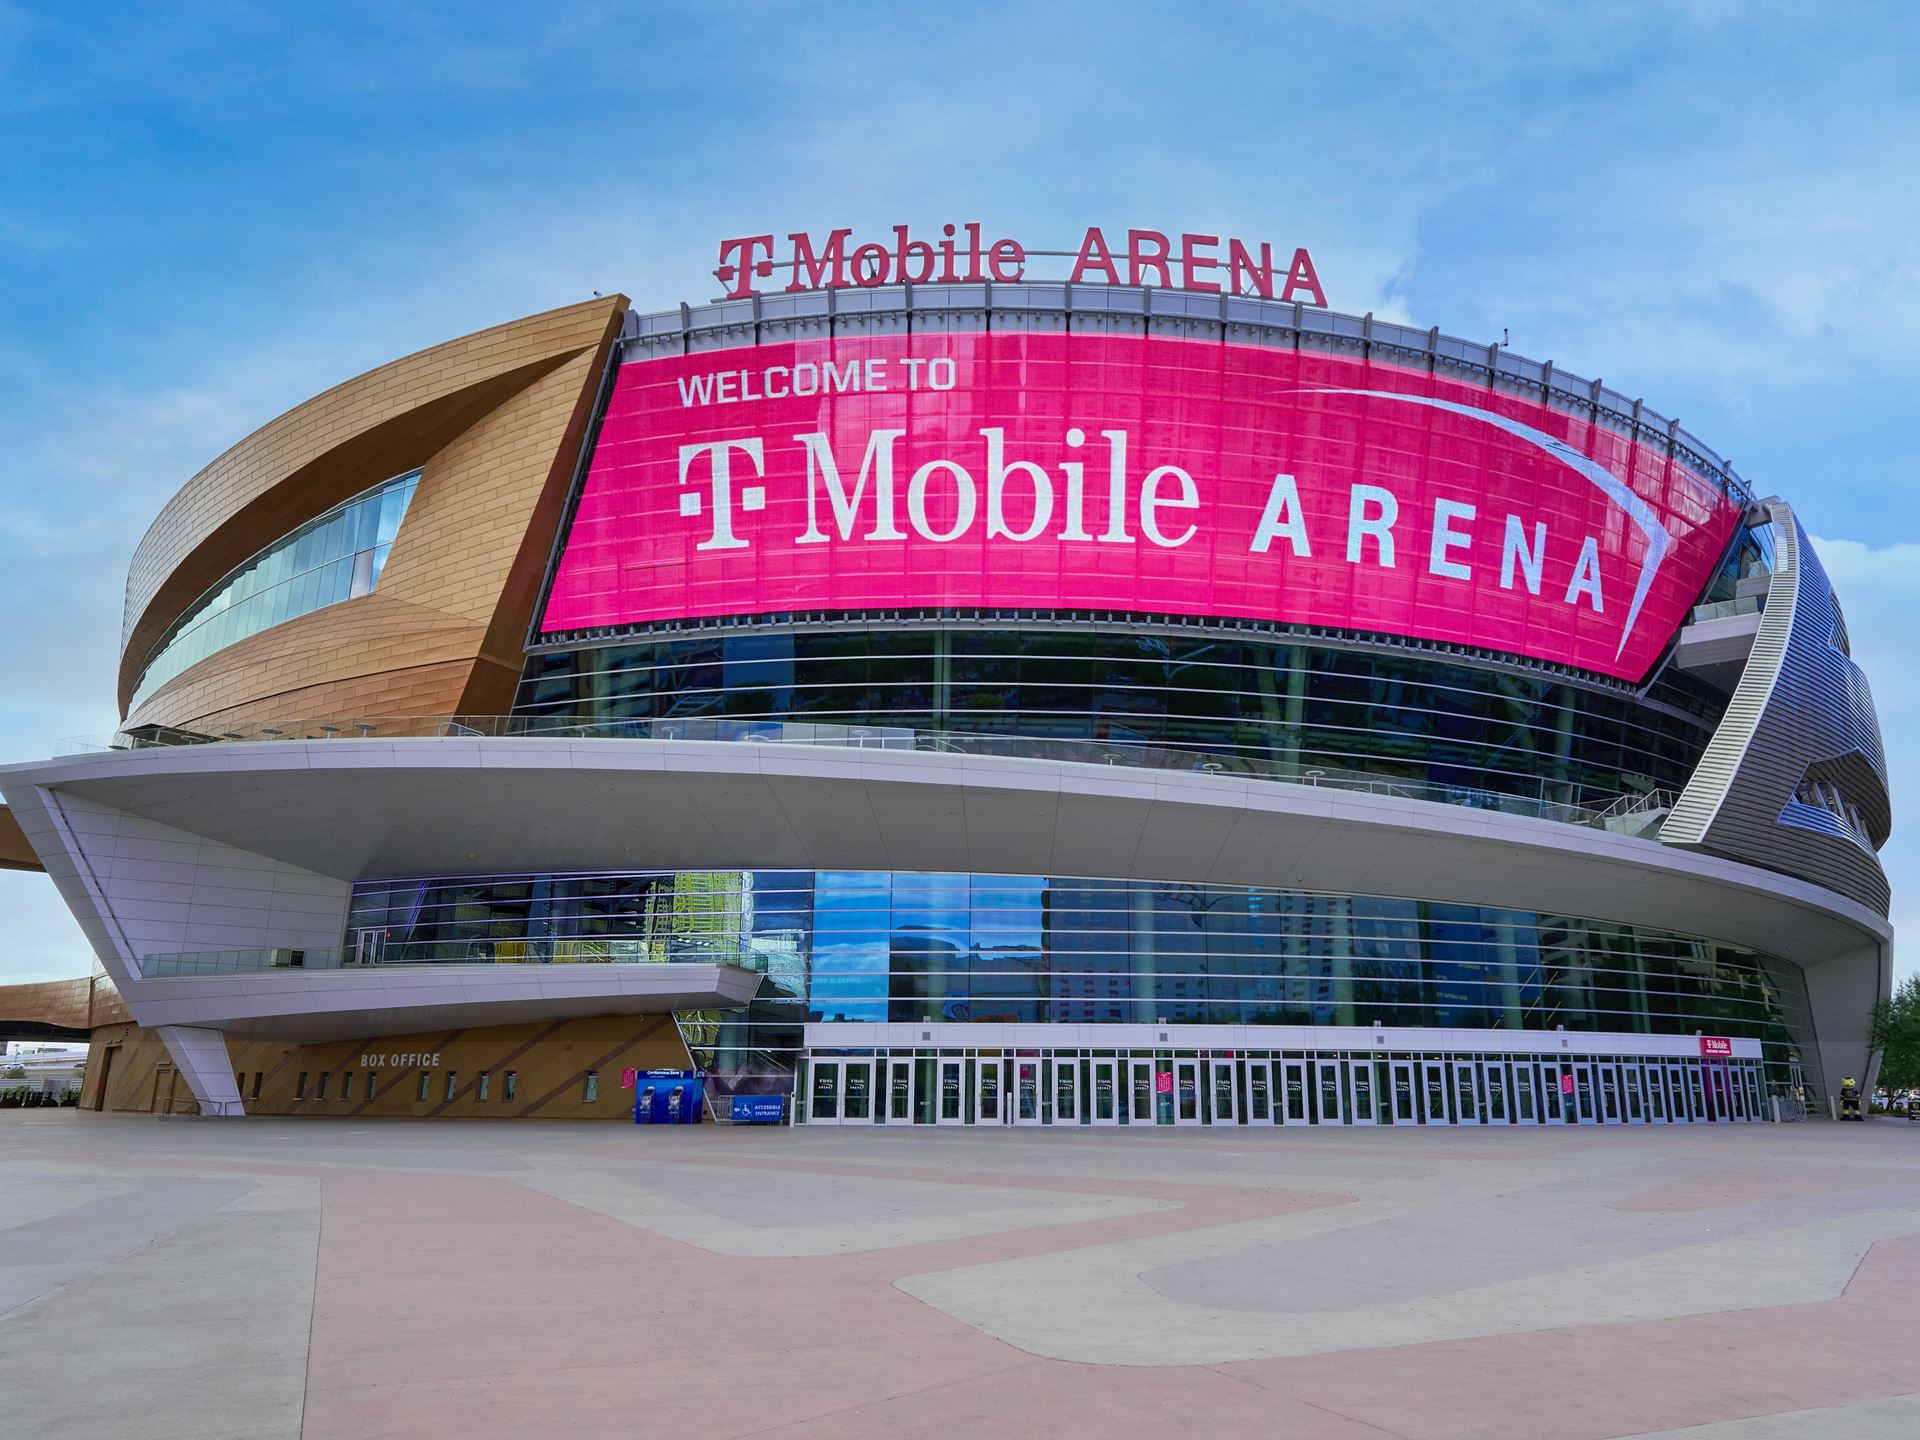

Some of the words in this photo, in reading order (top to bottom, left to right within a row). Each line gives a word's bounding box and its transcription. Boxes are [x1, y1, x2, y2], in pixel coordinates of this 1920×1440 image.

[785, 222, 1026, 293] Mobile
[1070, 226, 1328, 308] ARENA
[677, 358, 888, 409] WELCOME
[900, 357, 956, 391] TO
[793, 426, 1200, 548] Mobile
[1249, 473, 1604, 614] ARENA
[361, 1054, 386, 1067] BOX
[391, 1053, 440, 1067] OFFICE
